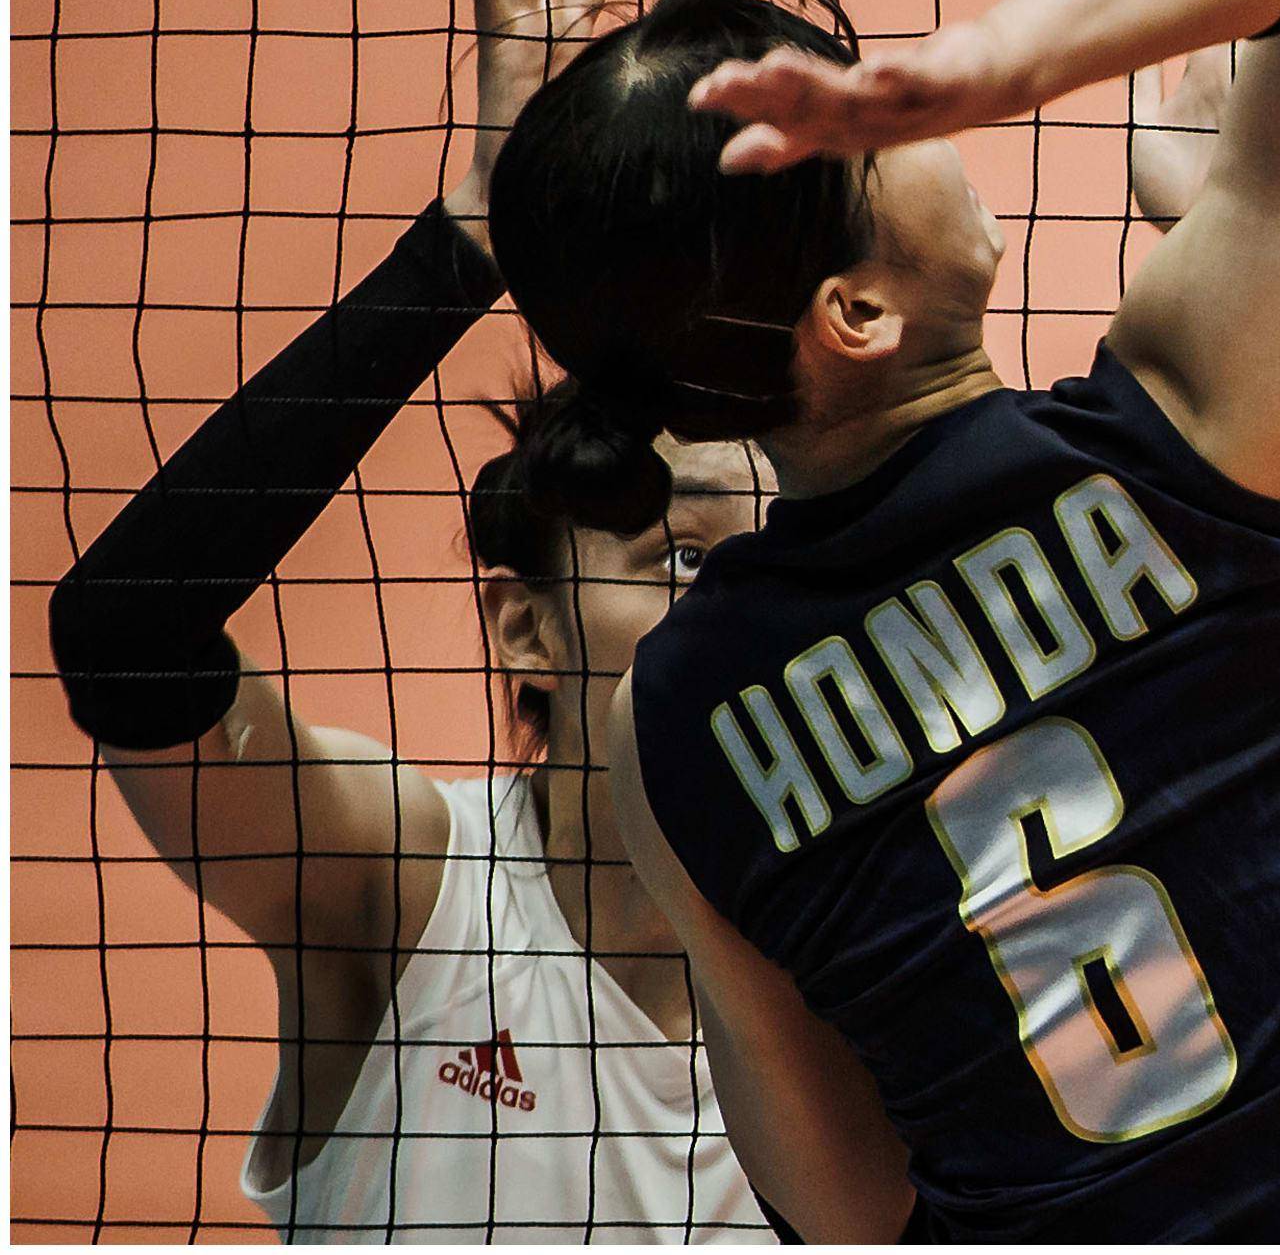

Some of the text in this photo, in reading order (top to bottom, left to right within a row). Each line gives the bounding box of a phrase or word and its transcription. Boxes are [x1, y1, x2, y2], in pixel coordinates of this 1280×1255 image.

[711, 473, 1198, 853] HONDA
[438, 1061, 537, 1112] adidas
[924, 716, 1238, 1144] 6
